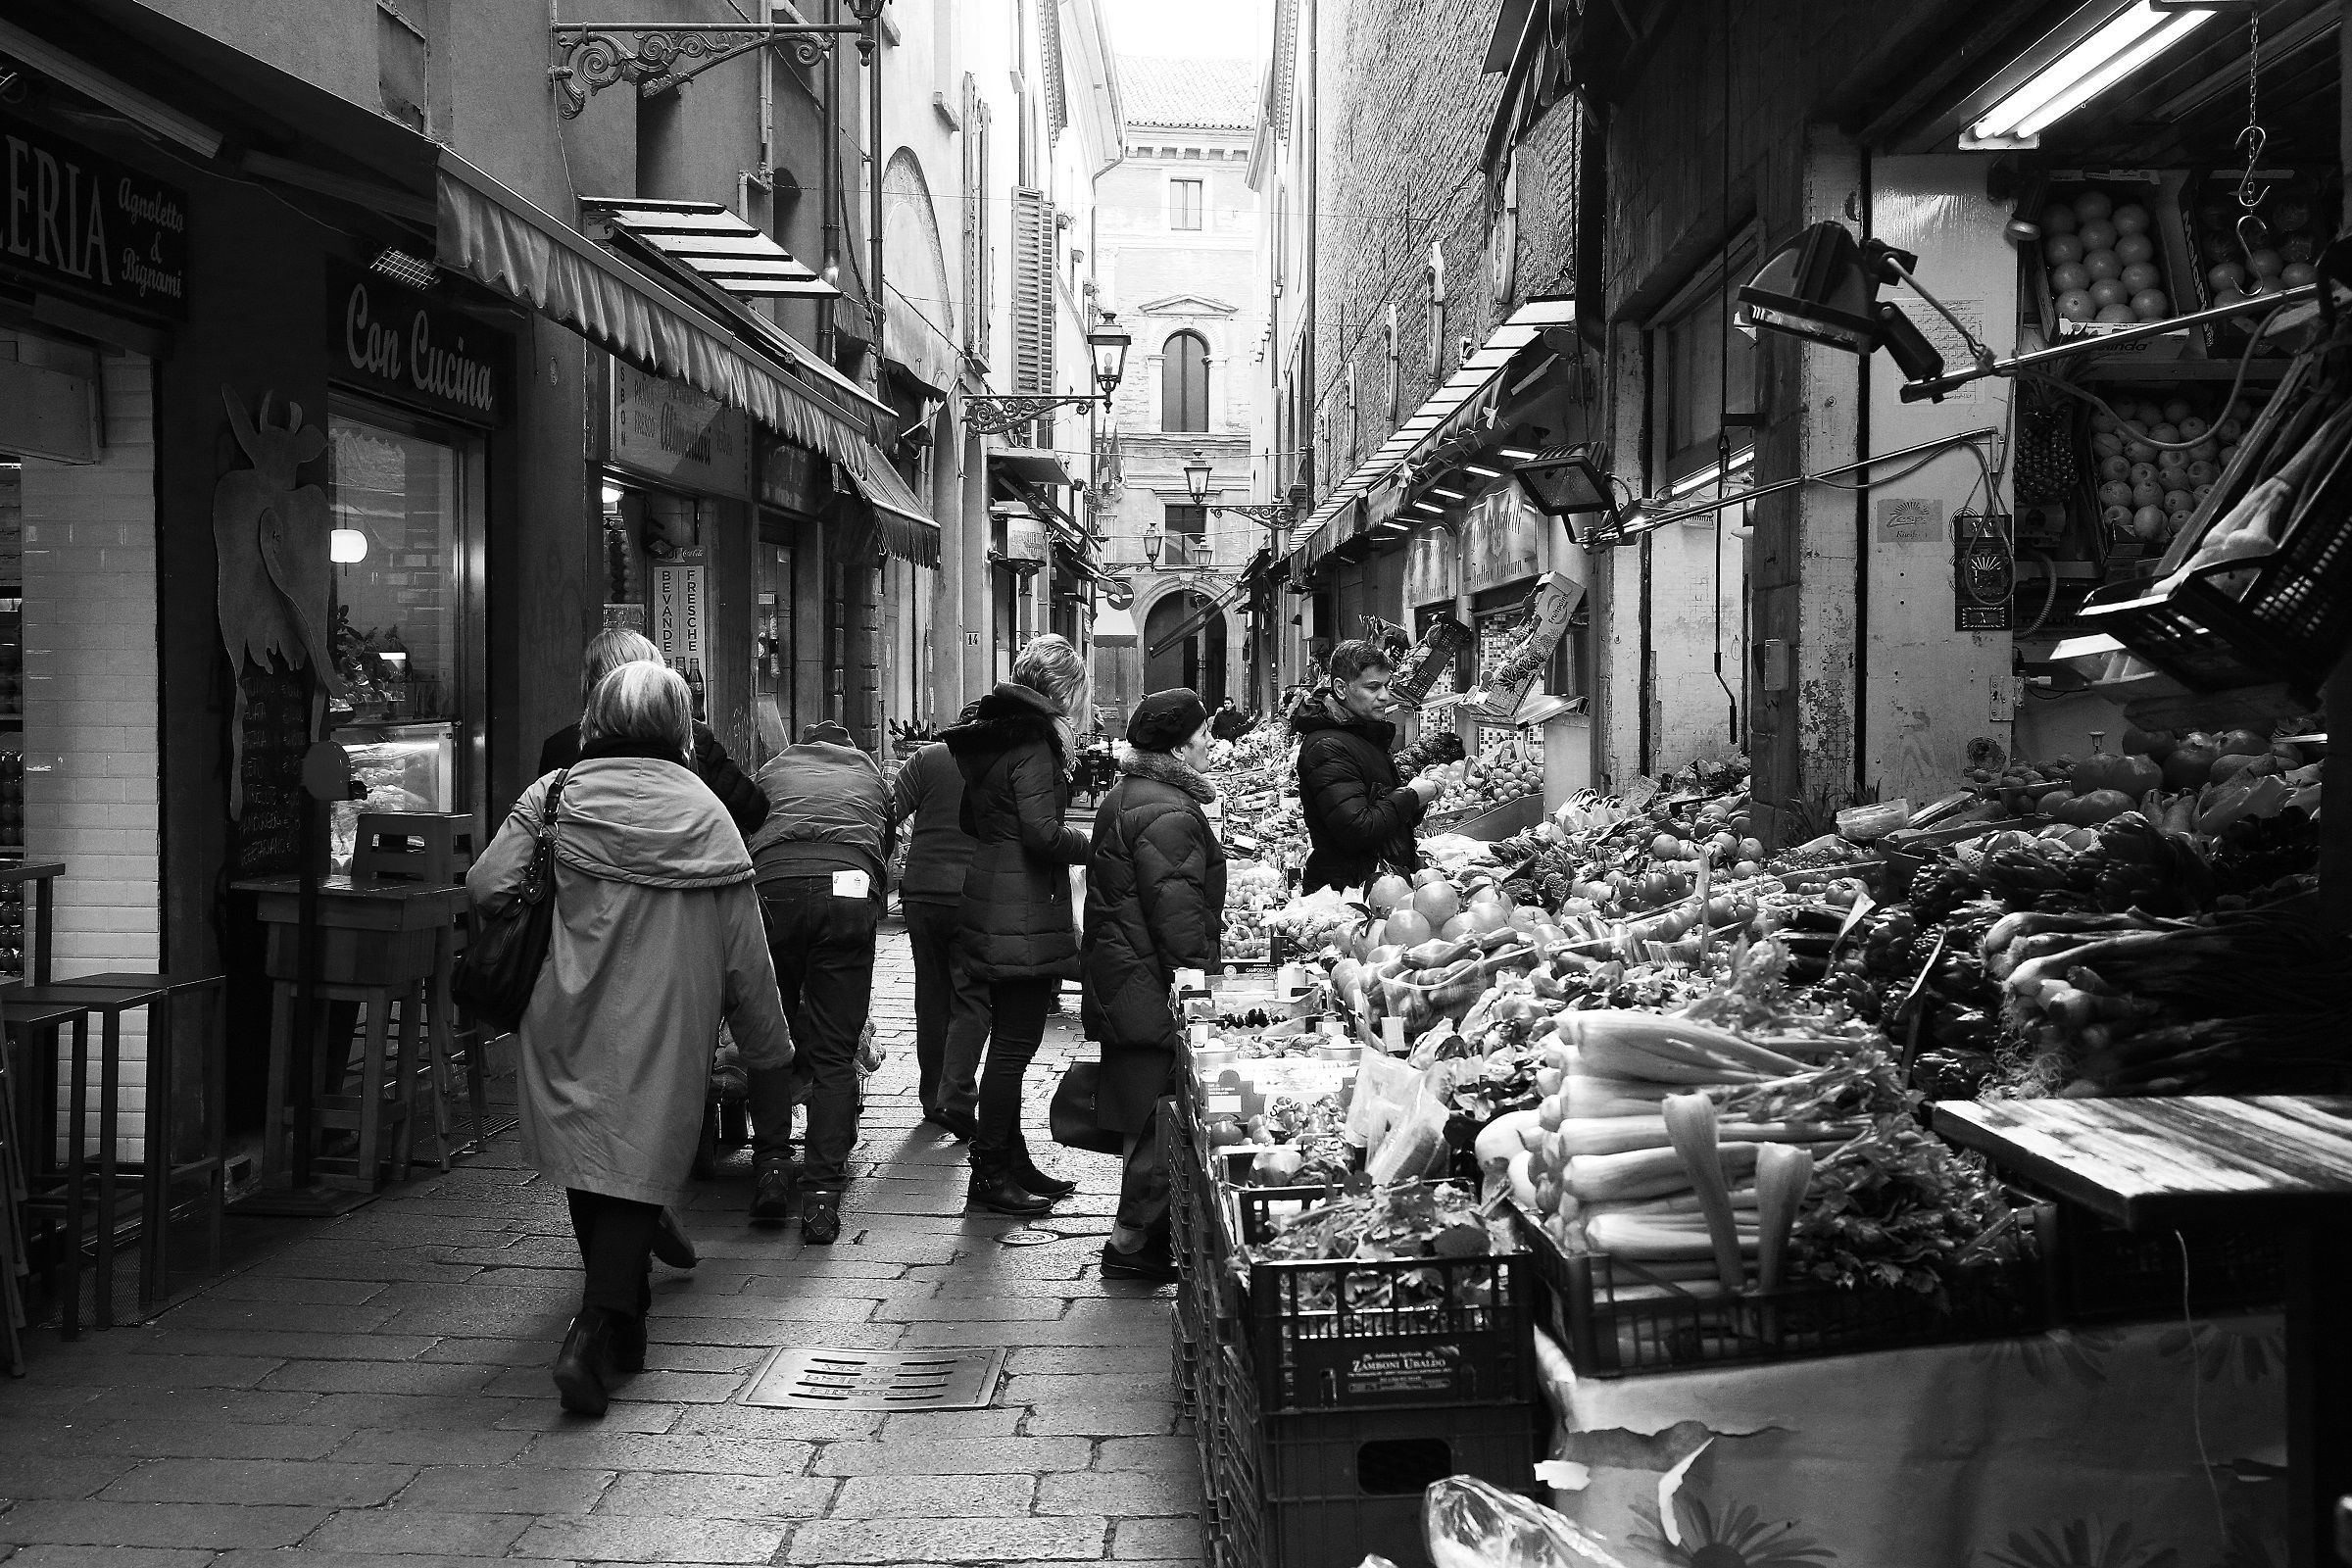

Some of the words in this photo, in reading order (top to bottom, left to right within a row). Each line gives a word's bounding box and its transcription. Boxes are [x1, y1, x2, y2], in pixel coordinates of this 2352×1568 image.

[0, 134, 113, 286] ERIA
[118, 177, 184, 234] Agnoletto
[122, 248, 182, 299] Bignami
[150, 231, 164, 265] &
[347, 283, 402, 380] Con
[411, 310, 493, 412] Cucina
[662, 570, 673, 654] BEVANDE
[687, 569, 698, 652] FRESCHE
[967, 633, 979, 646] 14
